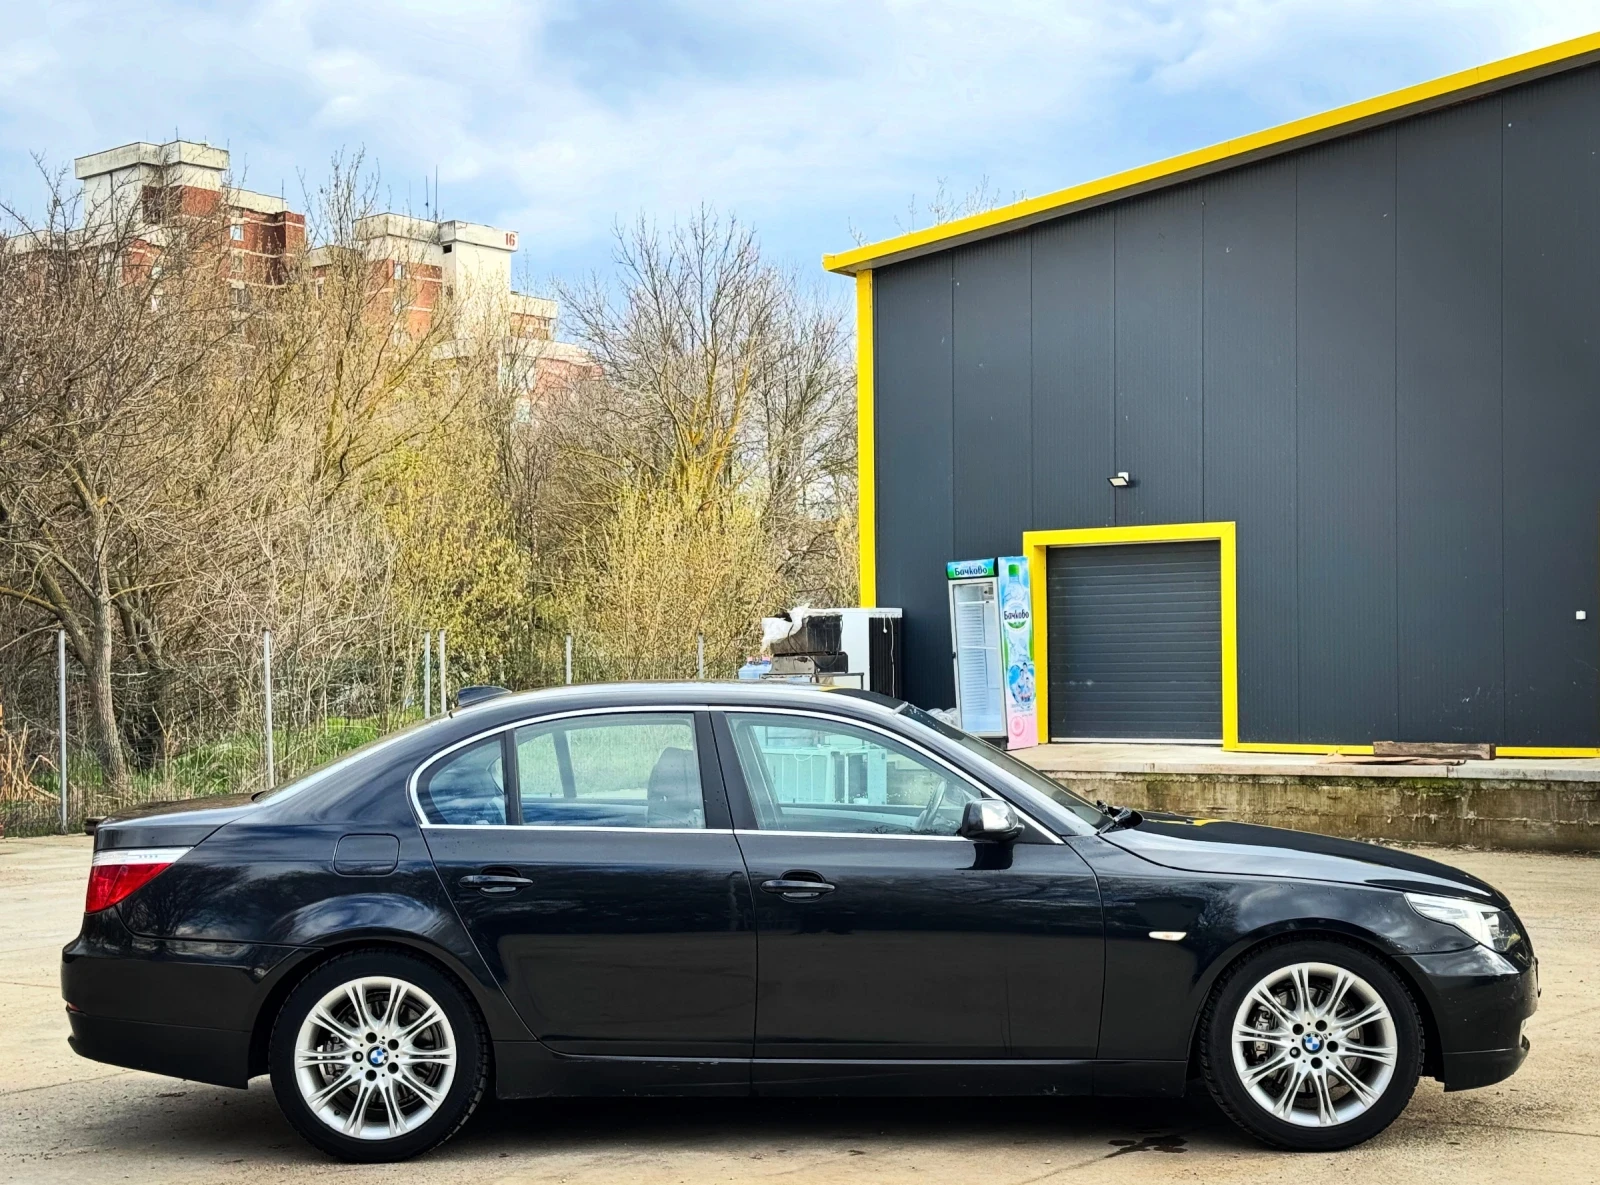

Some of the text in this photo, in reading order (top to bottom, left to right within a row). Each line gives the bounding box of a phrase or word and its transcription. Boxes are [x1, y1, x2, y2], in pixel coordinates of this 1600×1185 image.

[505, 233, 516, 246] 16
[954, 565, 988, 576] Бачково
[1003, 608, 1030, 621] Бачково
